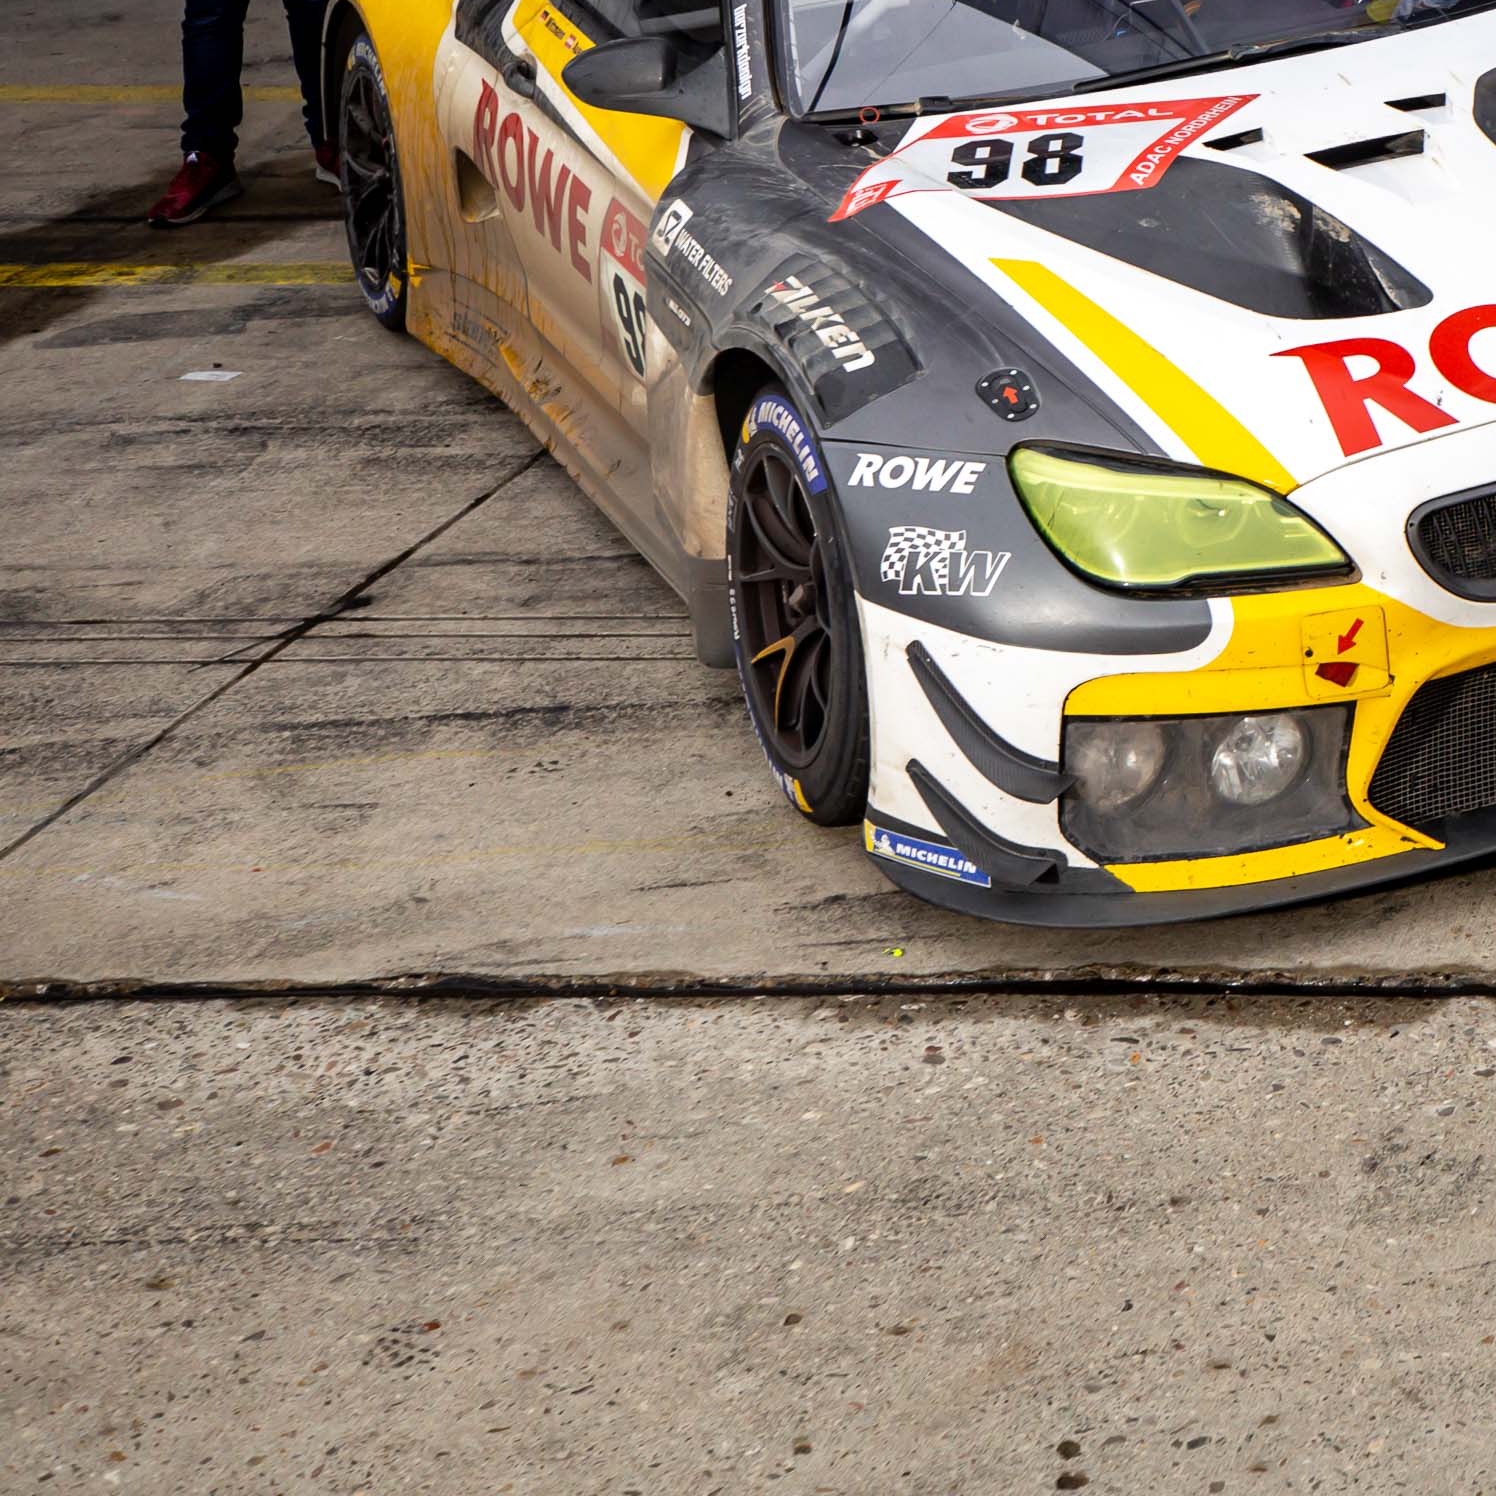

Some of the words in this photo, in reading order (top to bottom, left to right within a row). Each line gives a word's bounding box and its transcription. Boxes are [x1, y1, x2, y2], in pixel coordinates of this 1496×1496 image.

[1024, 108, 1175, 126] TOTAL
[1129, 140, 1173, 186] ADAC
[1167, 95, 1243, 152] NORDRHEIN
[473, 77, 593, 286] ROWE
[946, 132, 1085, 190] 98
[674, 229, 704, 268] WATER
[699, 250, 734, 296] FILTERS
[757, 398, 818, 485] MICHELIN
[848, 453, 987, 494] ROWE
[898, 549, 1012, 597] KW
[896, 844, 978, 875] MICHELIN
